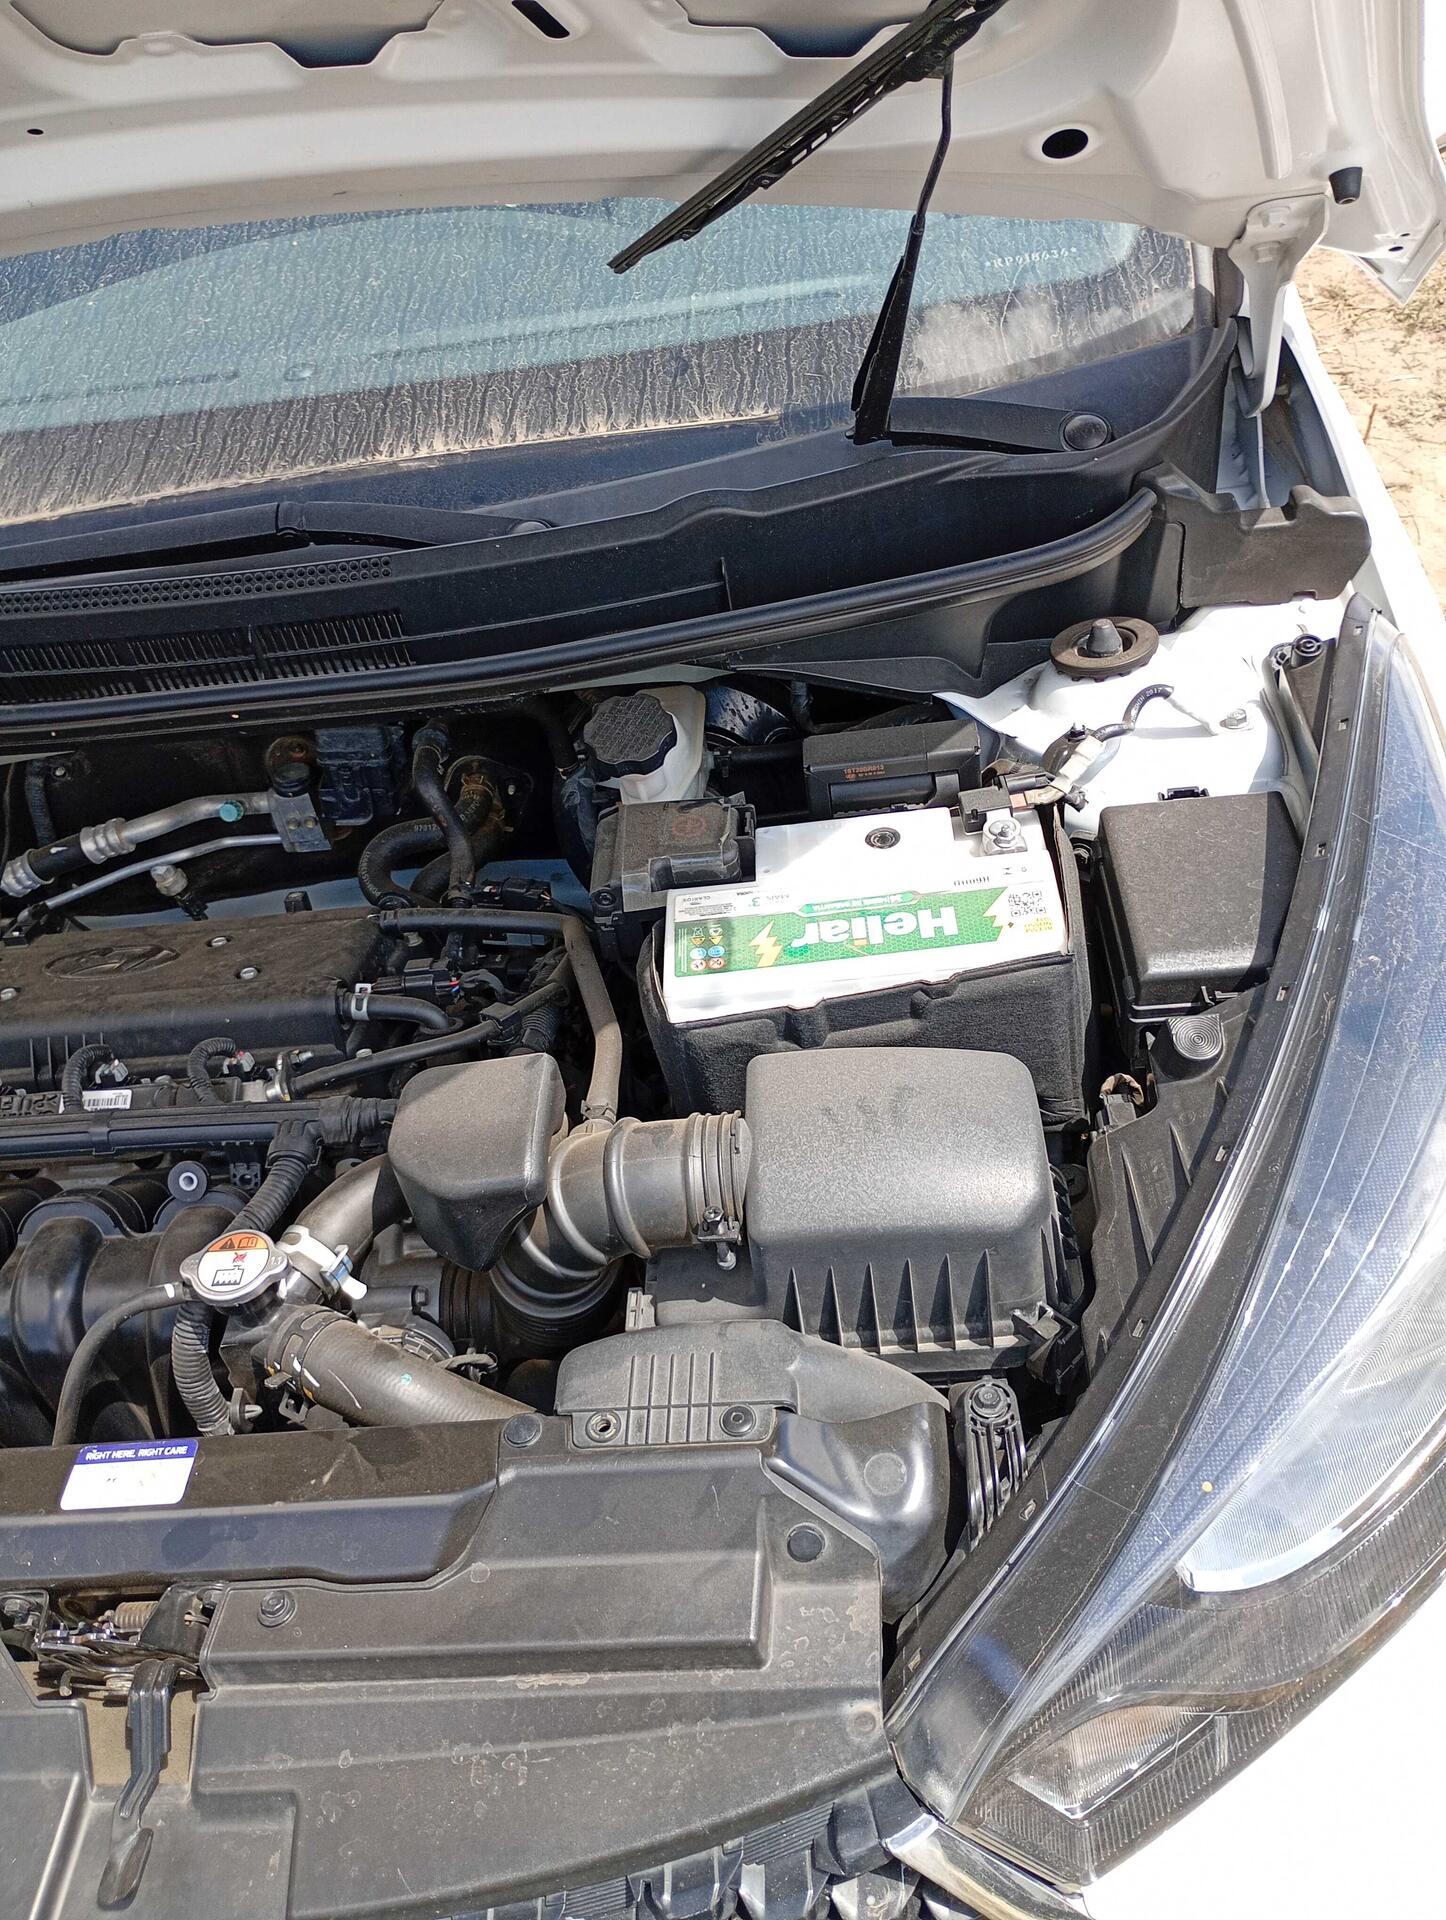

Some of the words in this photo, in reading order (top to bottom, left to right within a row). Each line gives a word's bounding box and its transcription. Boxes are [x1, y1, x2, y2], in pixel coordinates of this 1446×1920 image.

[786, 905, 958, 949] Heliar
[85, 1449, 112, 1461] RIGHT
[138, 1447, 164, 1458] RIGHT
[164, 1446, 188, 1456] CARE
